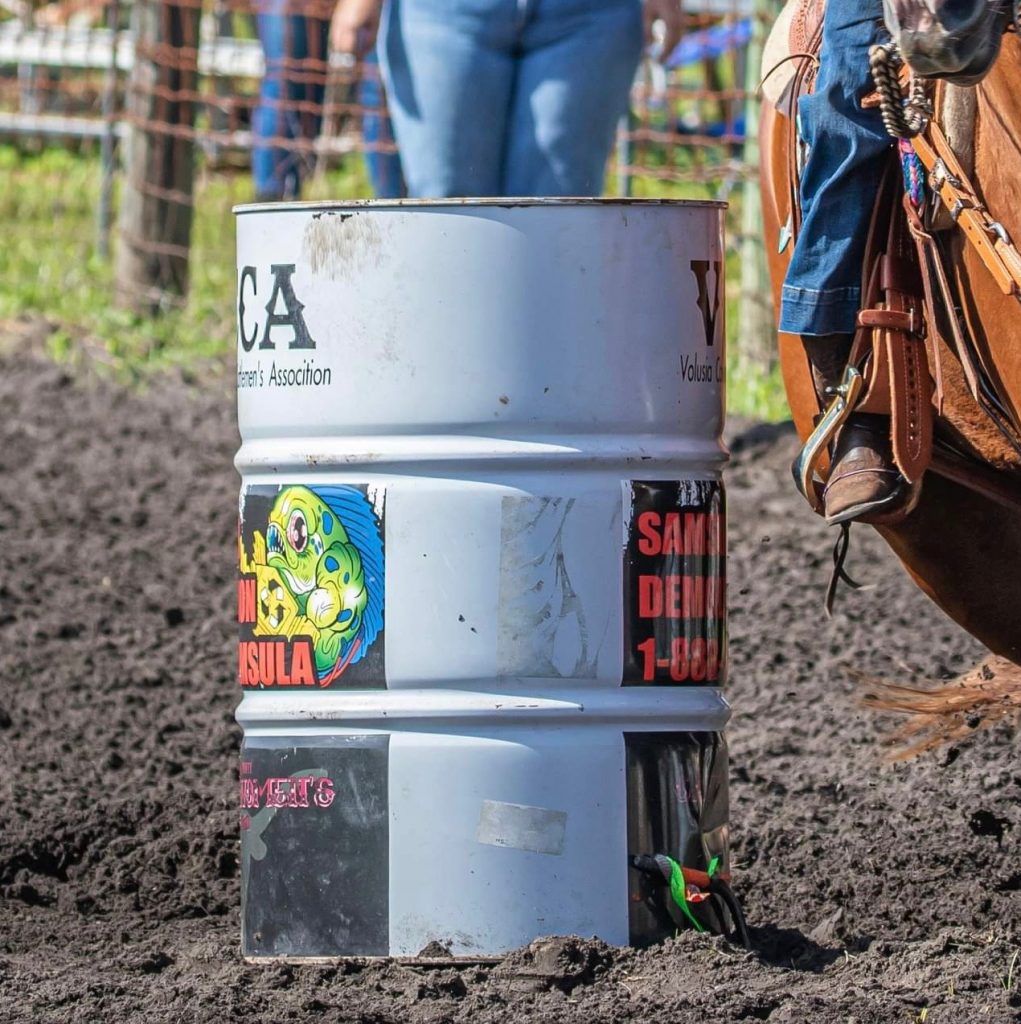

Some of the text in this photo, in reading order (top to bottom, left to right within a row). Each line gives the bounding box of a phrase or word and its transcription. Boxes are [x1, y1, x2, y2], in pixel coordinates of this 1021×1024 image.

[239, 263, 316, 352] CA
[268, 359, 332, 387] Assocition
[680, 353, 713, 382] Volusia
